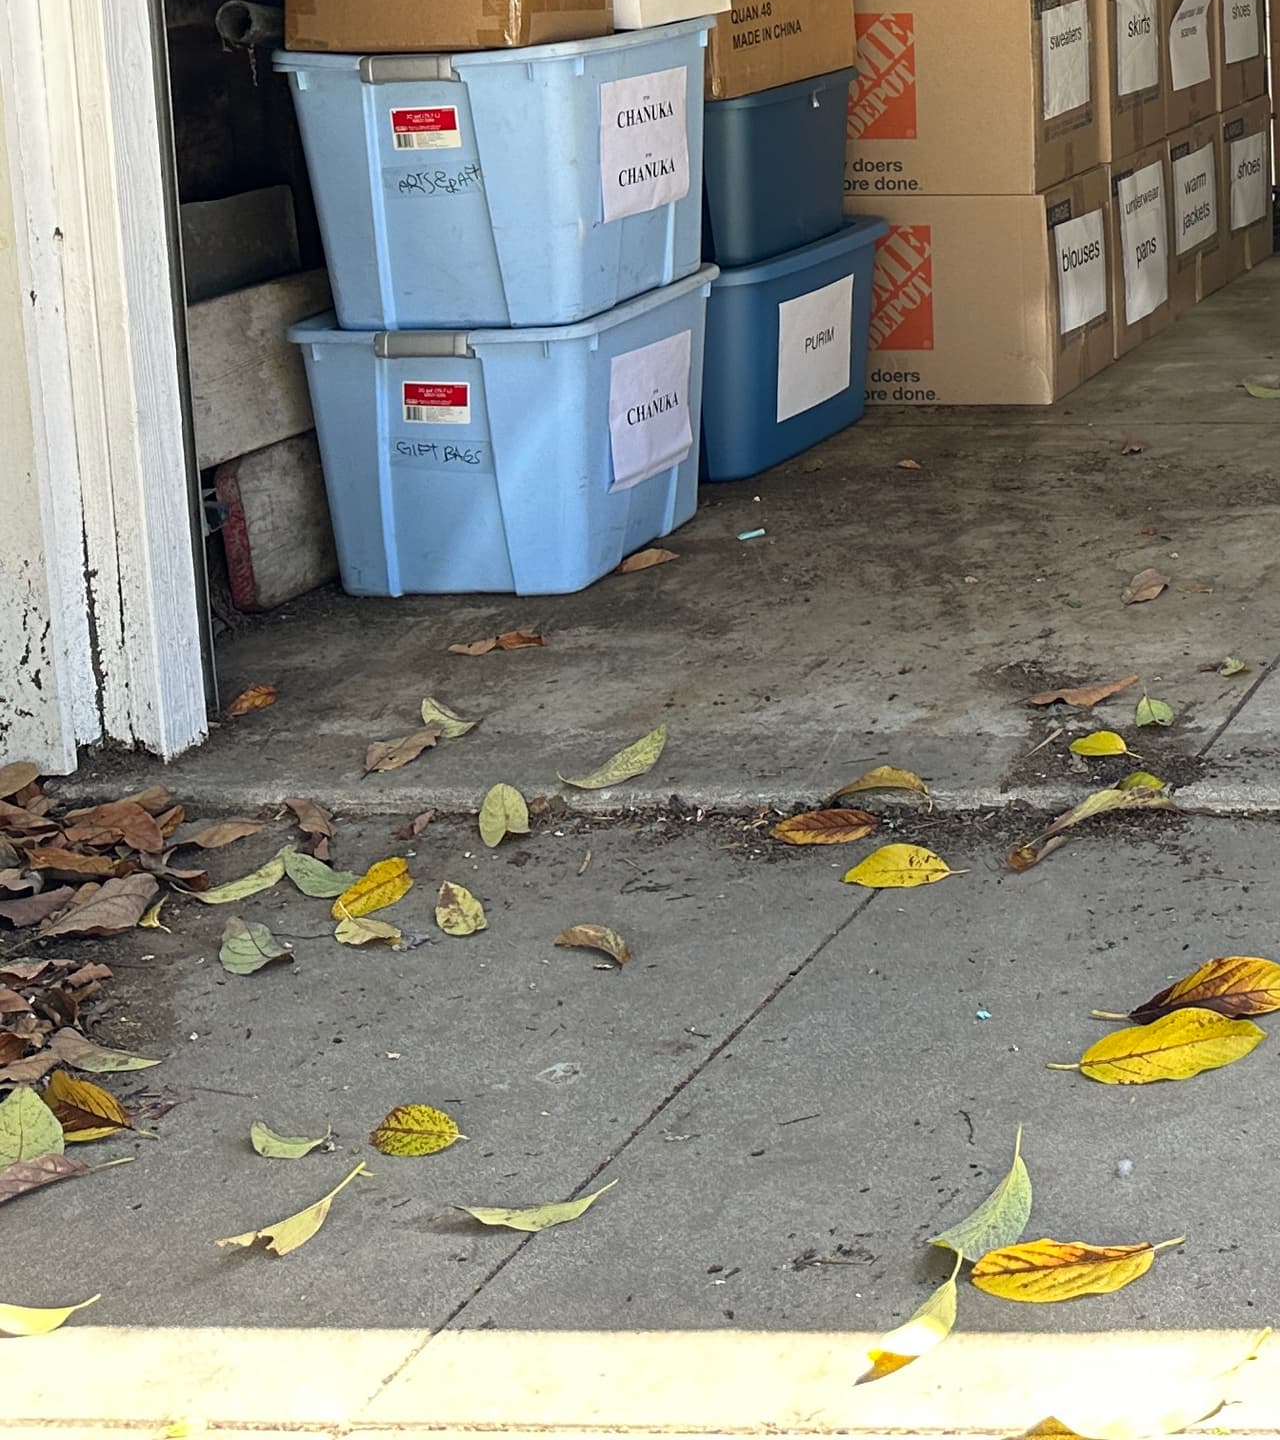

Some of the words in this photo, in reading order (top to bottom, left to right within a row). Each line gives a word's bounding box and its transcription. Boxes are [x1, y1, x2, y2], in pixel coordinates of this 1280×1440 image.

[761, 1, 772, 17] 48
[1231, 3, 1251, 20] shoes
[732, 28, 760, 50] MADE
[762, 26, 772, 41] IN
[773, 19, 802, 39] CHINA
[1050, 25, 1083, 50] sweaters
[1128, 14, 1151, 38] skirts
[846, 59, 916, 140] DEPOT
[617, 101, 674, 128] CHANUKA
[618, 157, 675, 187] CHANUKA
[853, 159, 903, 173] doers
[1236, 157, 1261, 180] shoes
[844, 178, 869, 191] ore
[1184, 171, 1207, 195] warm
[1182, 200, 1211, 237] jackets
[1061, 239, 1100, 272] blouses
[1136, 236, 1157, 269] pans
[868, 271, 933, 350] DEPOT
[805, 325, 834, 353] PURIM
[871, 368, 921, 383] doers
[864, 389, 888, 401] ore
[627, 391, 679, 426] CHANUKA
[396, 441, 438, 461] GIFT
[443, 445, 483, 464] BAGS
